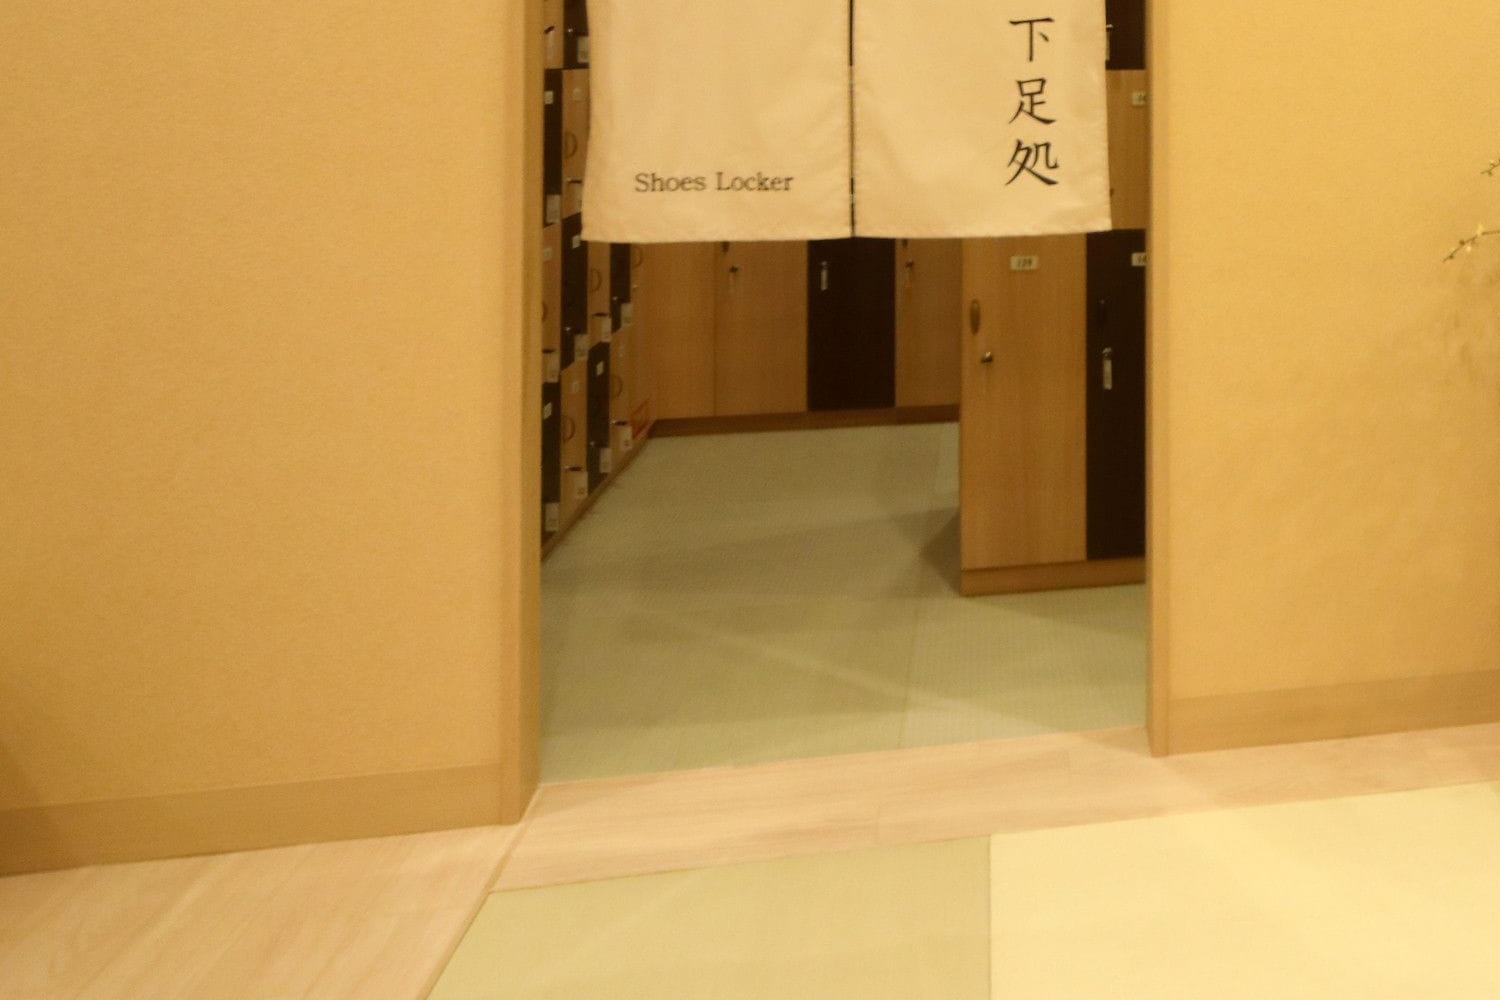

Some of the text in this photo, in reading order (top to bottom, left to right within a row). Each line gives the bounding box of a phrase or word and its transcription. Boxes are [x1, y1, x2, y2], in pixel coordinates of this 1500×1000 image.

[1004, 16, 1060, 186] 下足処
[634, 171, 795, 193] Shoes Locker
